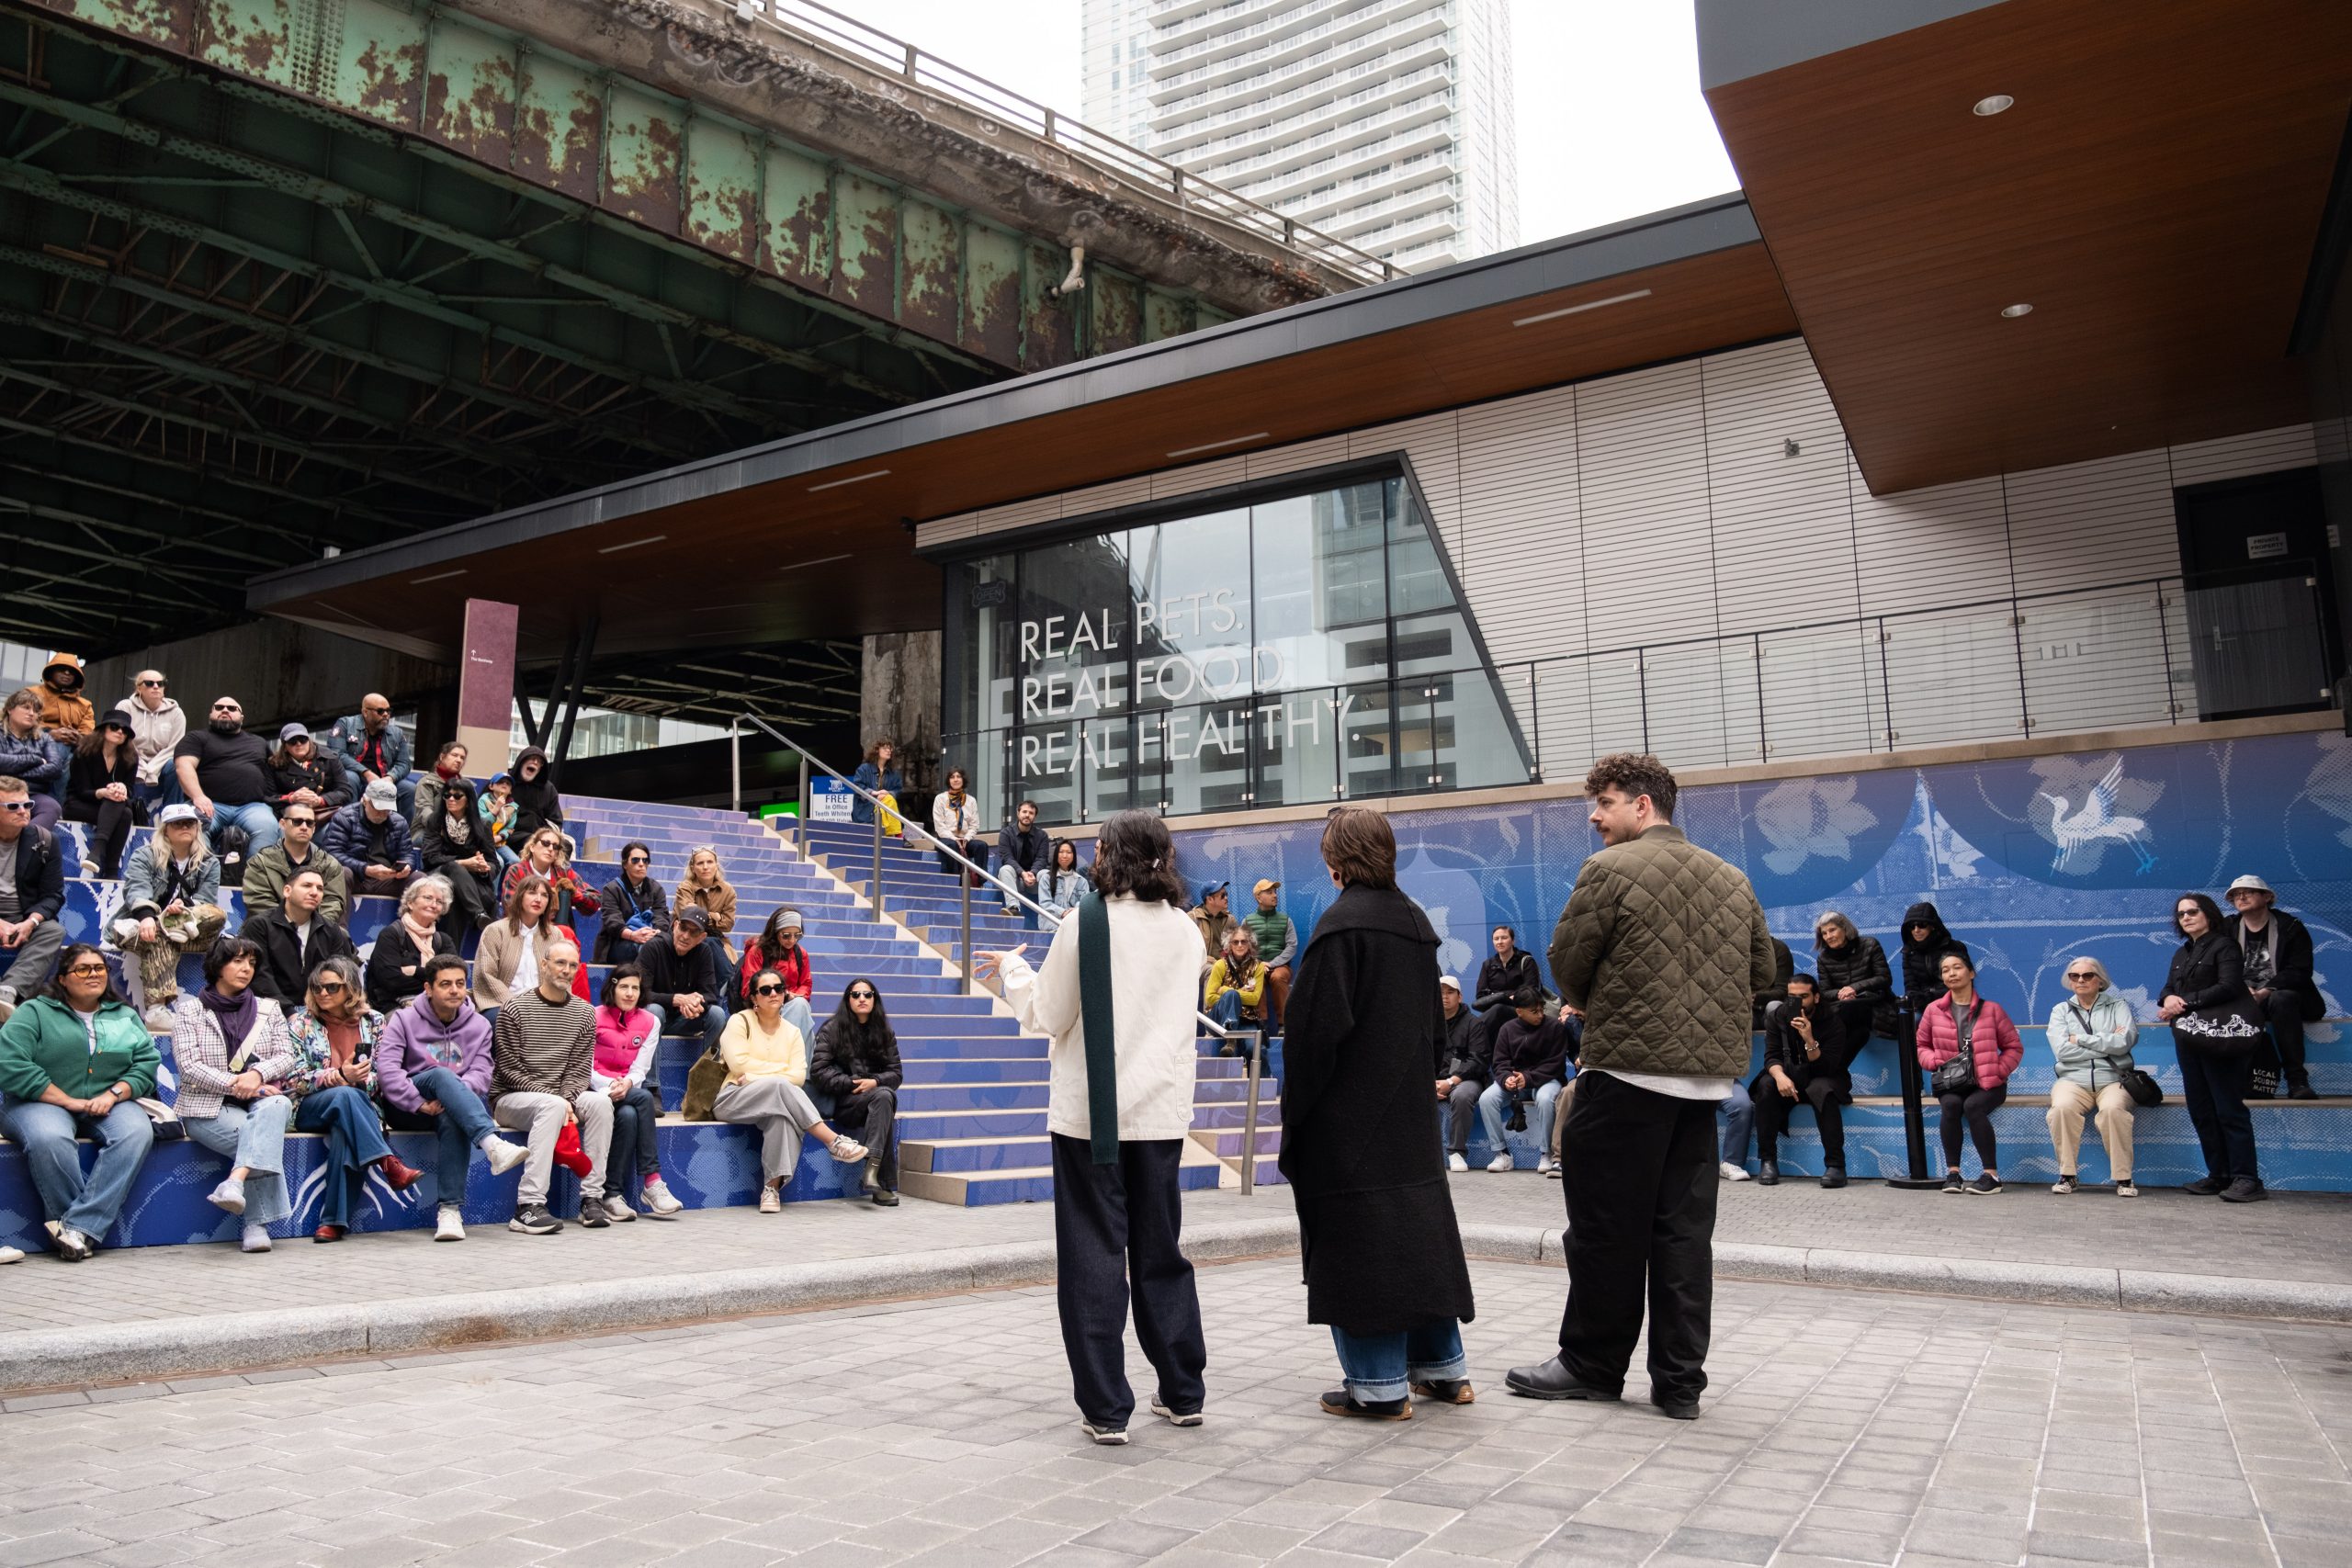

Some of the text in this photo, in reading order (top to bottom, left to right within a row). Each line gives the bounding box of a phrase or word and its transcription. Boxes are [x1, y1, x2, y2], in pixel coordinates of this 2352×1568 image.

[1021, 587, 1244, 662] REAL PETS.
[1022, 666, 1120, 719] REAL
[1021, 694, 1360, 777] REAL HEALTHY.
[825, 795, 848, 803] FREE
[2253, 1068, 2277, 1078] LOCAL
